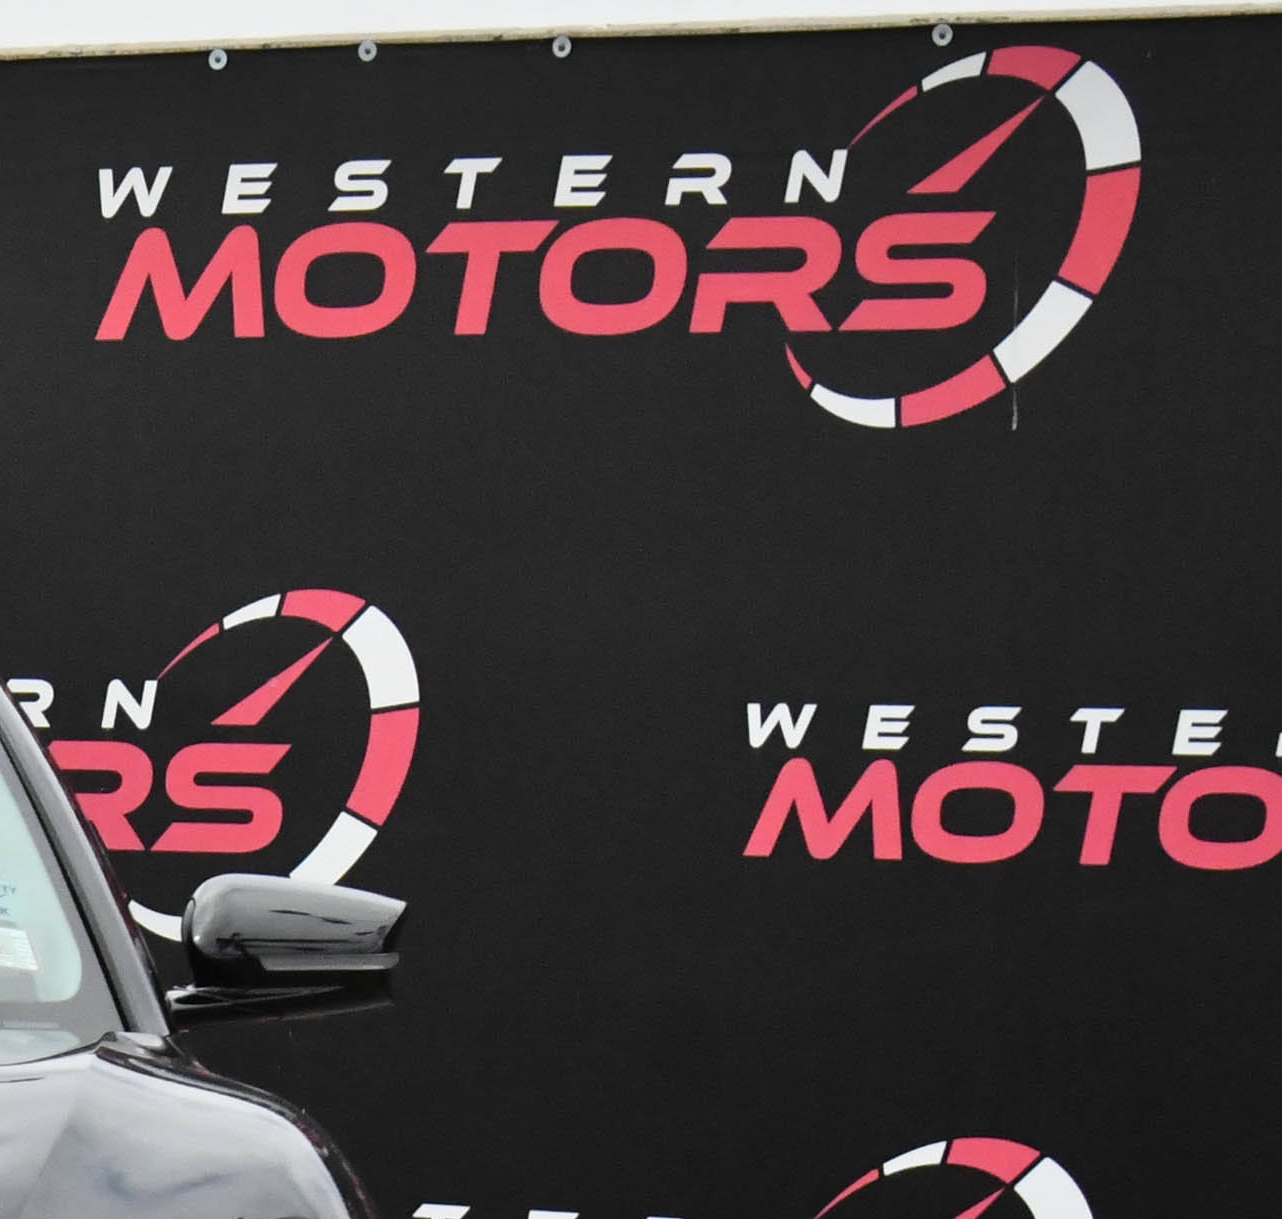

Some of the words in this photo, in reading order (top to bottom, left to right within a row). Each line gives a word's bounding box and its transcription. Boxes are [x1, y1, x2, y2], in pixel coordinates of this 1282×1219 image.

[99, 150, 847, 218] WESTERN
[97, 212, 995, 340] MOTORS
[747, 703, 1282, 756] WESTE
[744, 758, 1282, 870] MOTO
